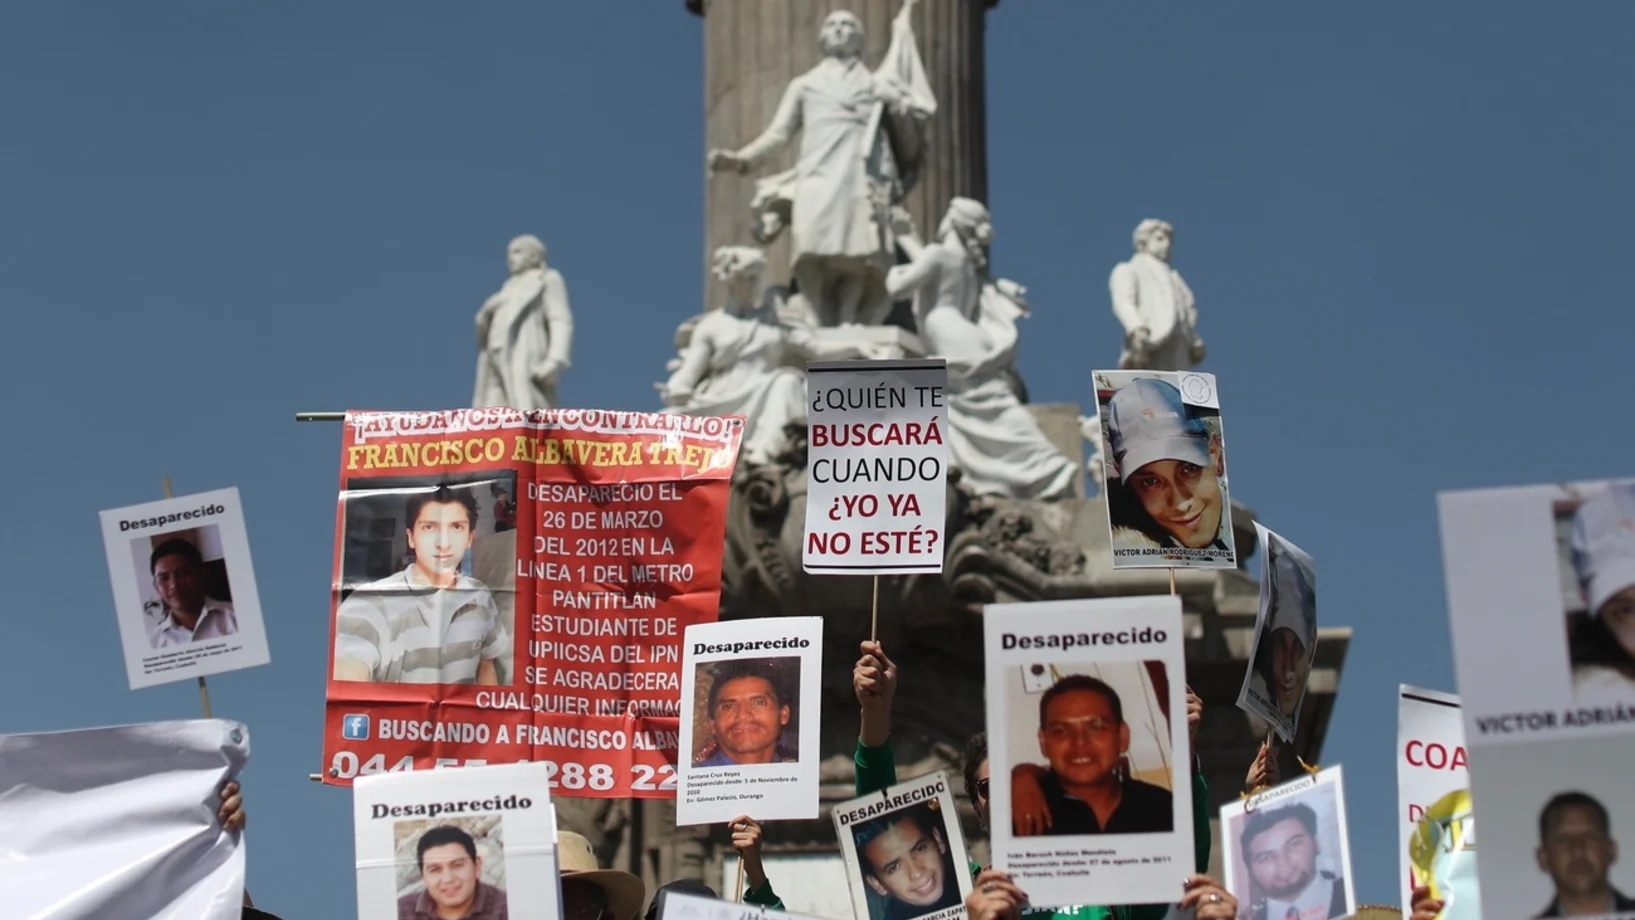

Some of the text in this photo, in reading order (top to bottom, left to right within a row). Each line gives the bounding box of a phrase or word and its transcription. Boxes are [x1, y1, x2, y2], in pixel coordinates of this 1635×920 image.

[812, 382, 944, 412] ¿QUIÉN TE
[812, 416, 943, 447] BUSCARÁ
[346, 436, 732, 473] FRANCISCO ALBAVERA TREJO
[812, 456, 941, 483] CUANDO
[659, 483, 683, 501] EL
[119, 503, 225, 532] Desaparecido
[828, 493, 921, 521] ¿YO YA
[543, 510, 663, 529] 26 DE MARZO
[535, 536, 675, 556] DEL 2012 EN LA
[808, 525, 939, 555] NO ESTÉ?
[1114, 548, 1141, 556] VICTOR
[517, 559, 693, 583] LINEA 1 DEL METRO
[532, 614, 678, 636] ESTUDIANTE DE
[529, 640, 679, 663] UPIICSA DEL IPN
[693, 637, 810, 656] Desaparecido
[1001, 627, 1168, 652] Desaparecido
[525, 666, 679, 690] SE AGRADECERA
[476, 691, 590, 716] CUALQUIER
[378, 719, 490, 744] BUSCANDO
[495, 724, 511, 744] A
[516, 724, 626, 750] FRANCISCO
[1476, 711, 1558, 735] VICTOR
[332, 751, 414, 779] 044
[687, 780, 723, 788] Desaparecido
[371, 795, 532, 819] Desaparecido
[840, 781, 945, 825] DESAPARECIDO
